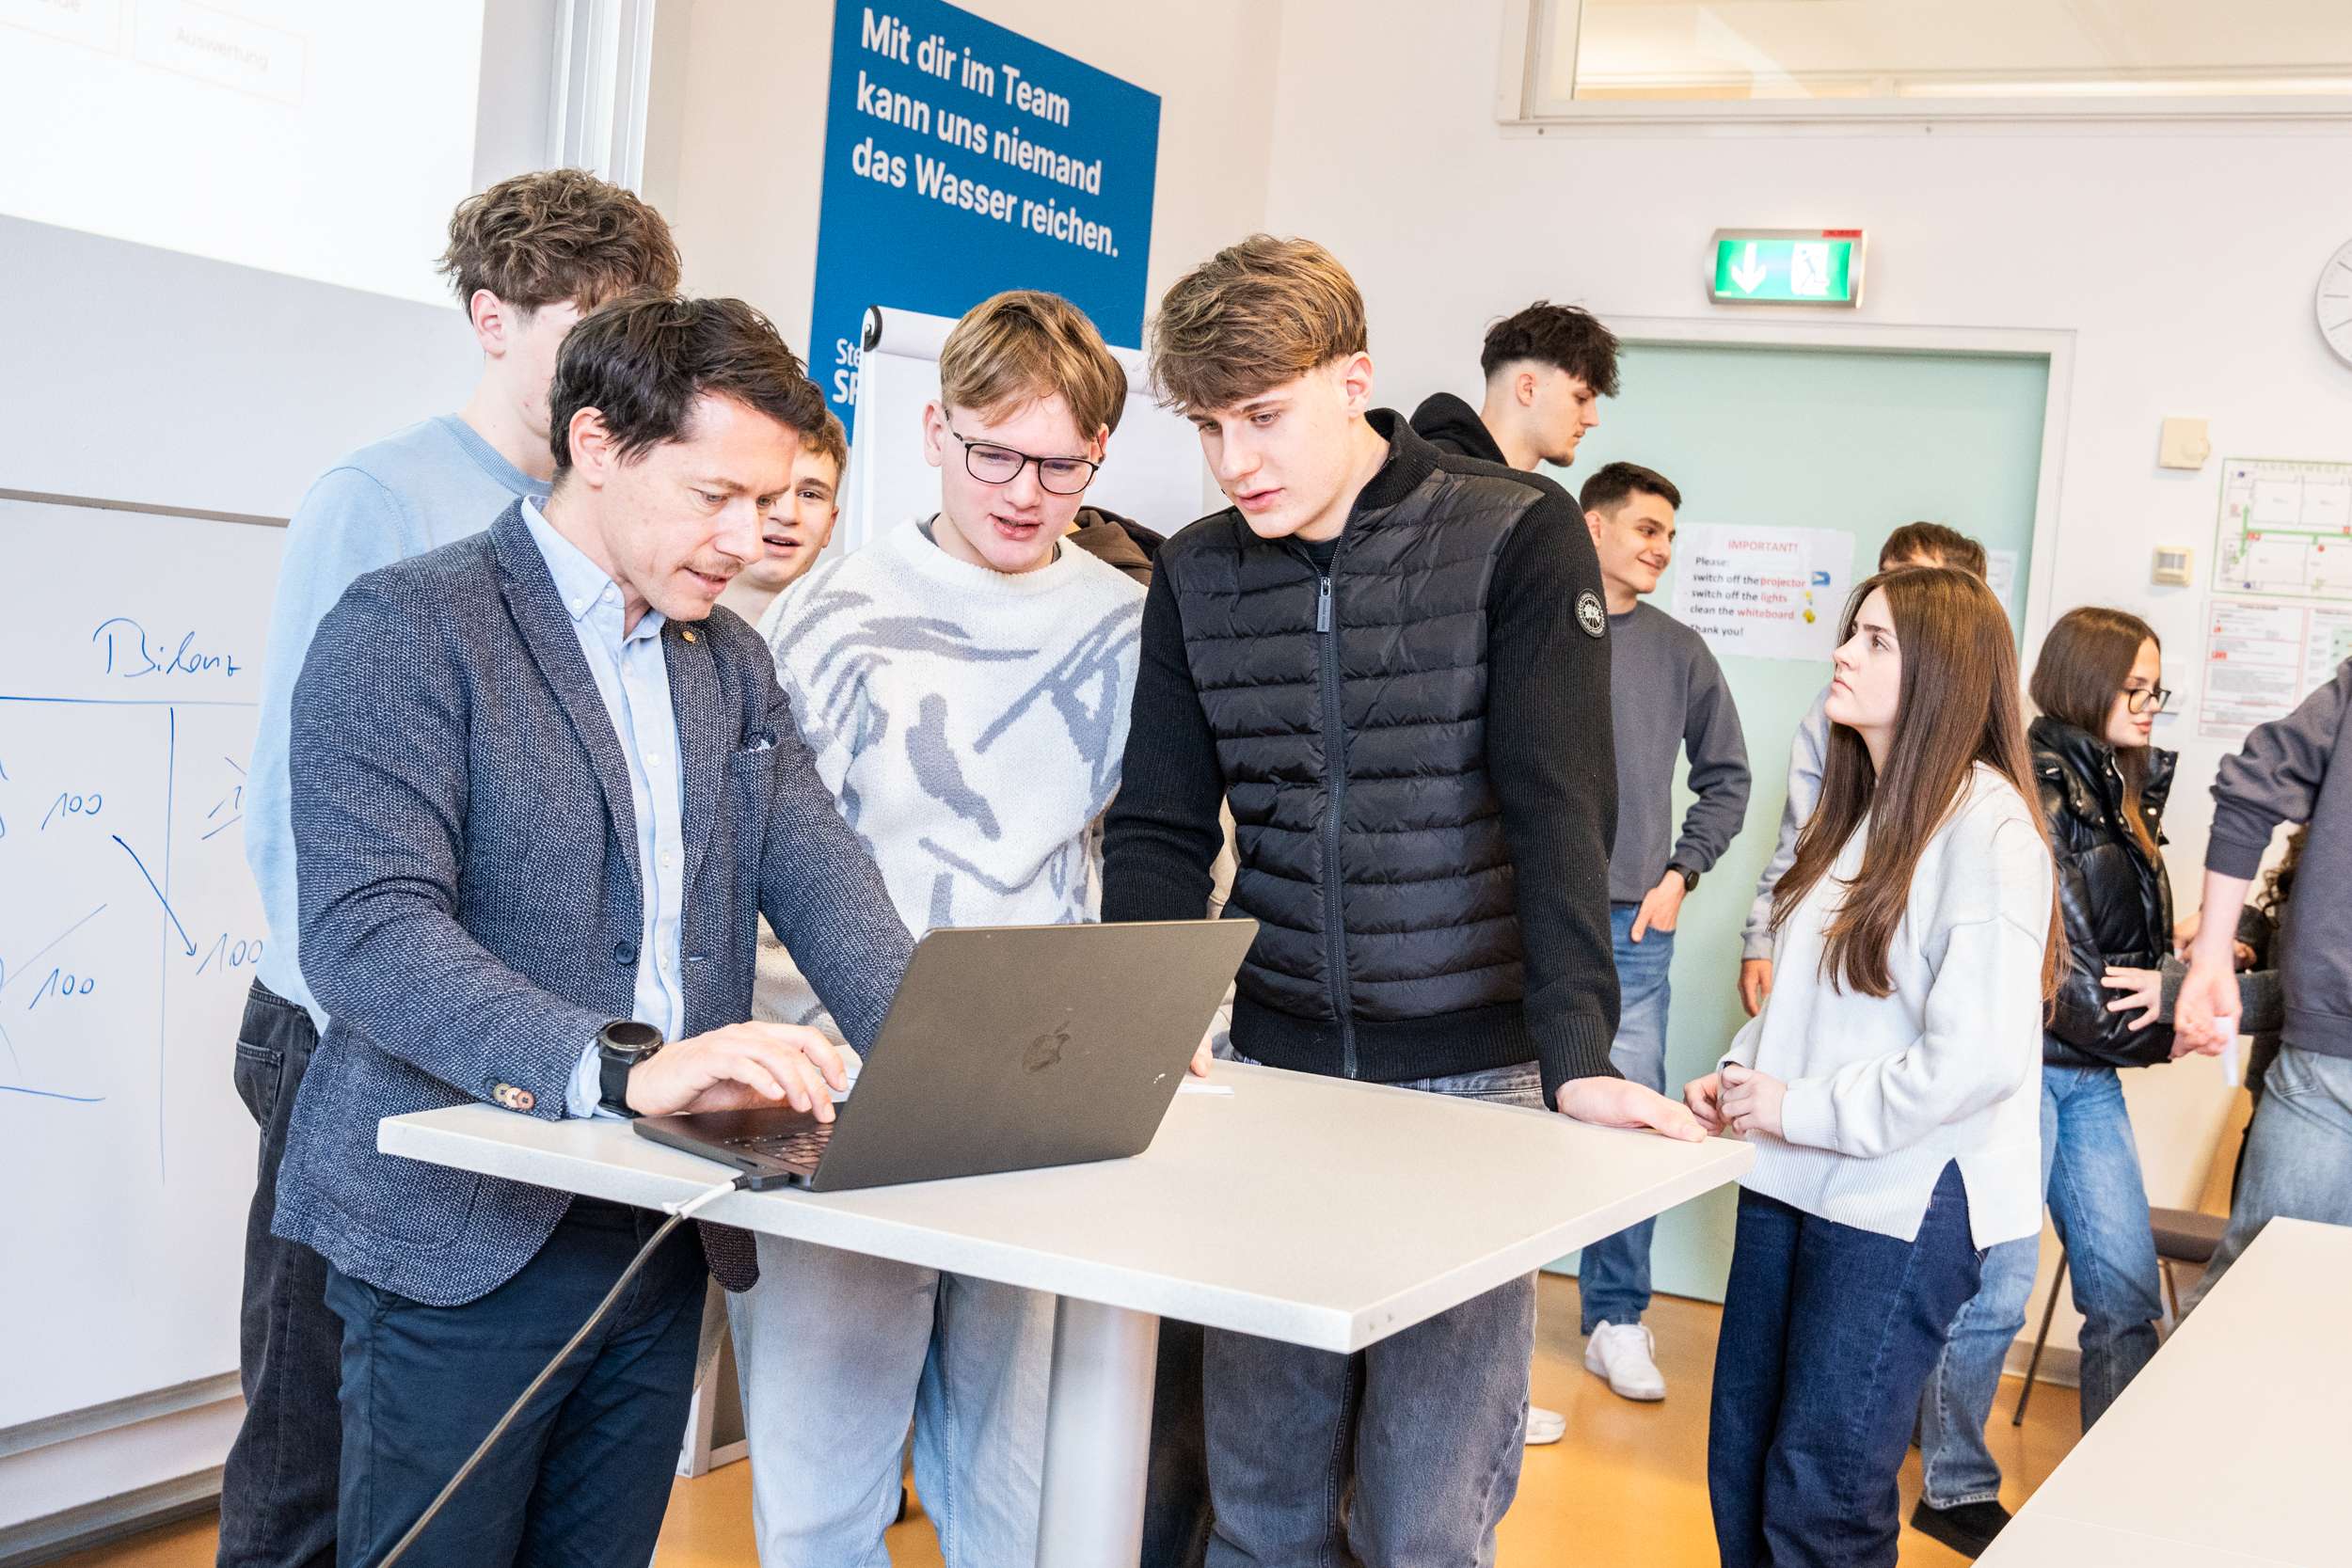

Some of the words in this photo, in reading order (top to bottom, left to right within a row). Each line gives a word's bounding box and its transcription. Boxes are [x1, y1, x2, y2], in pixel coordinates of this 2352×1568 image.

[175, 26, 269, 71] Auswertung
[861, 8, 912, 65] Mit
[917, 34, 957, 81] dir
[961, 47, 995, 98] im
[1002, 64, 1070, 128] Team
[857, 70, 930, 135] kann
[937, 109, 988, 154] uns
[993, 126, 1102, 196] niemand
[852, 136, 907, 188] das
[915, 153, 1018, 223] Wasser
[1022, 198, 1119, 258] reichen.
[1695, 556, 1730, 567] Please:
[1728, 540, 1798, 553] IMPORTANT!
[1692, 574, 1724, 583] switch
[1726, 575, 1741, 584] off
[1743, 576, 1759, 585] the
[1760, 577, 1805, 589] projector
[1692, 590, 1723, 599] switch
[1724, 591, 1740, 600] off
[1741, 592, 1758, 601] the
[1760, 593, 1788, 604] lights
[1690, 605, 1715, 614] clean
[1718, 606, 1734, 616] the
[1737, 608, 1794, 620] whiteboard
[1721, 627, 1743, 637] you!
[40, 792, 103, 831] 100
[196, 932, 263, 975] 100
[28, 968, 94, 1010] 100
